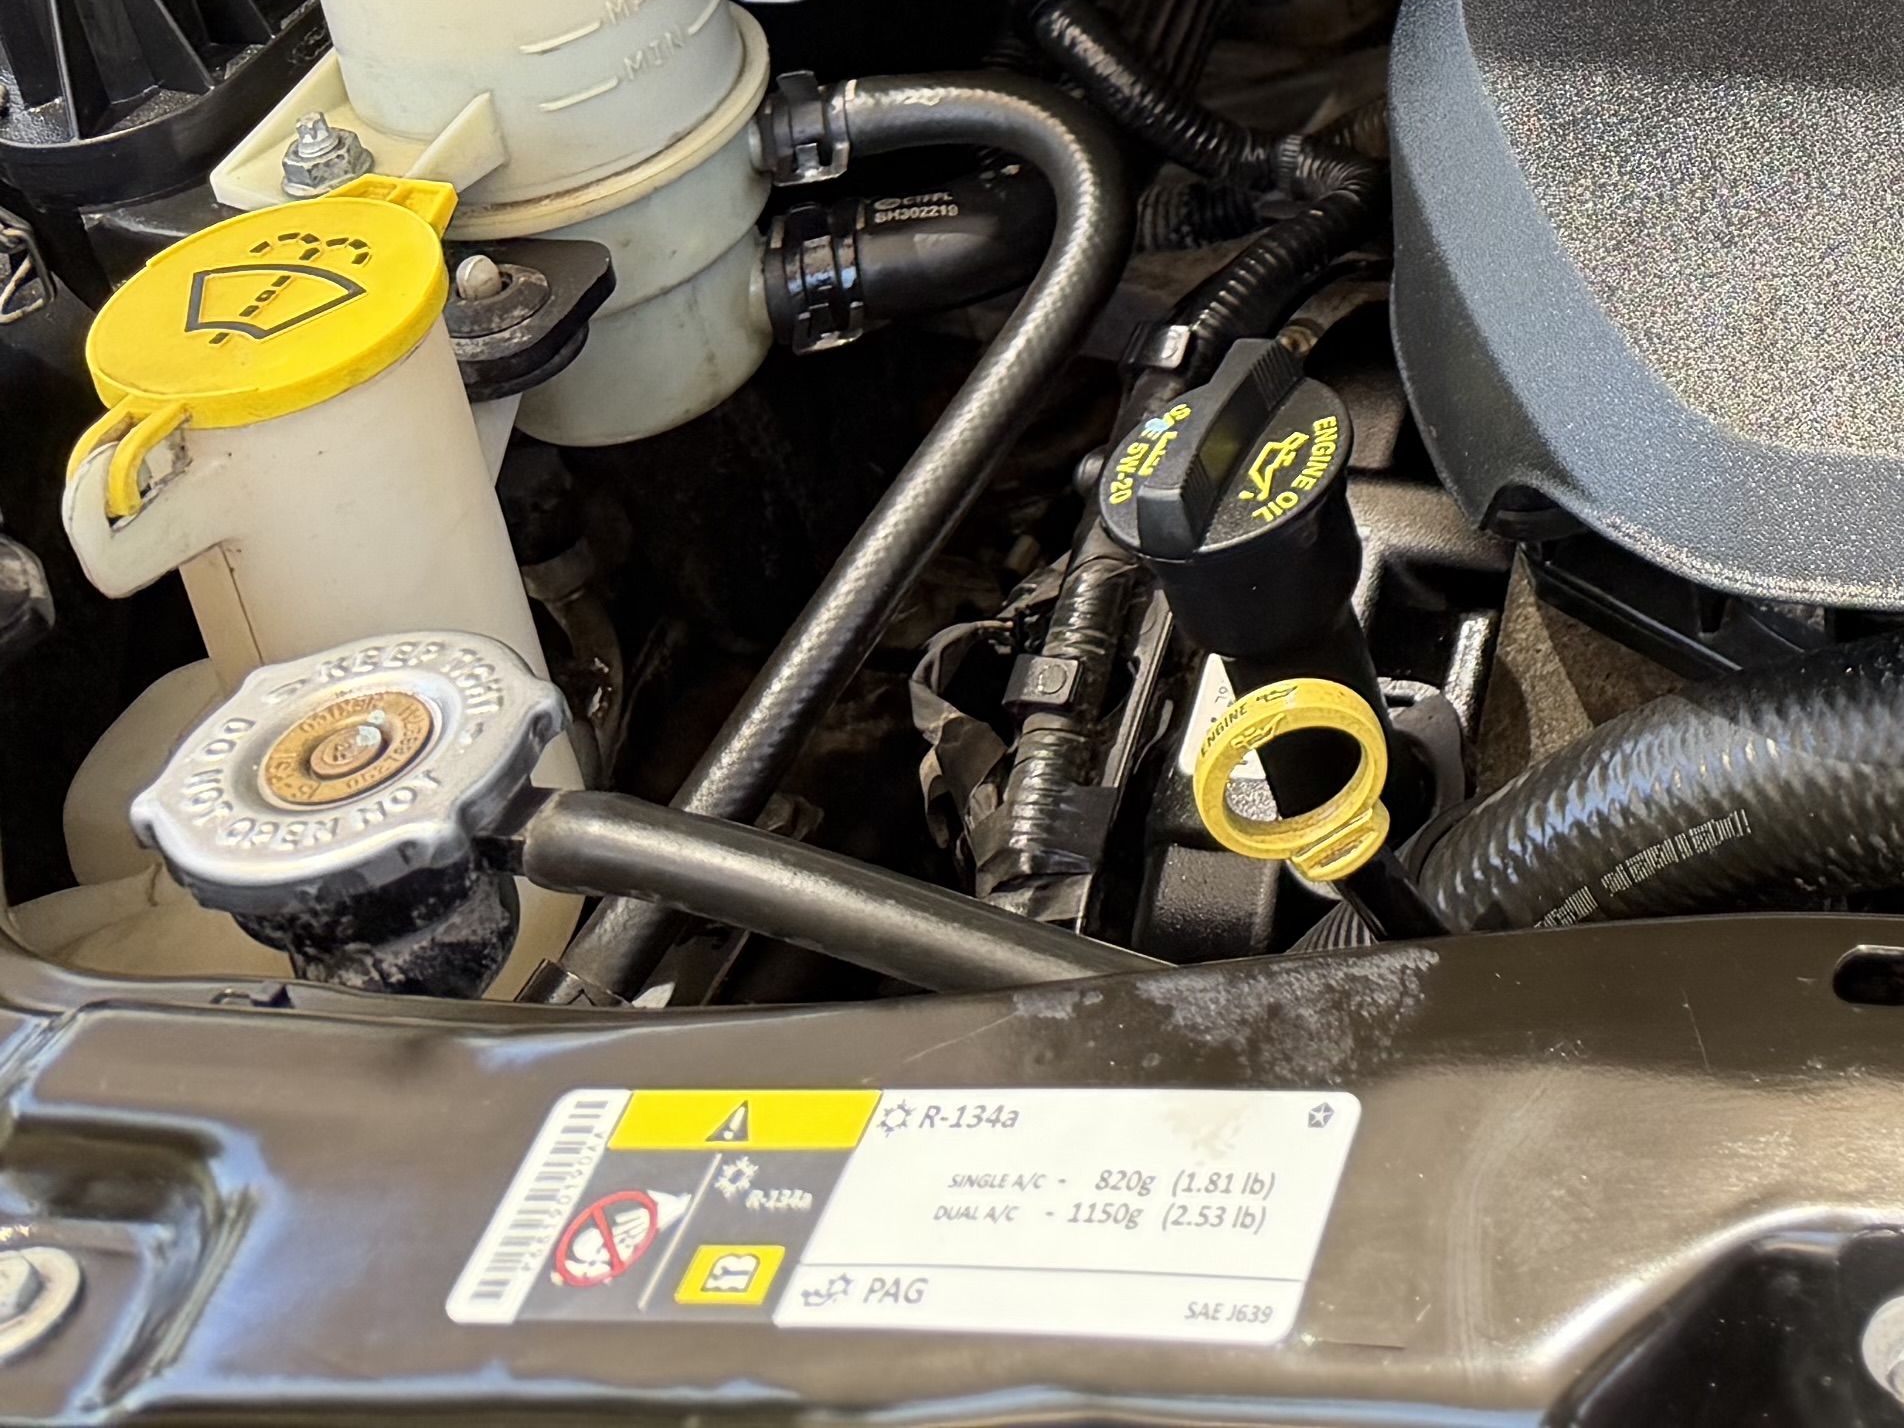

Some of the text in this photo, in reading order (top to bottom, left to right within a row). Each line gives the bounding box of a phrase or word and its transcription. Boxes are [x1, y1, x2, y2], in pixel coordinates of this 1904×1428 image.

[624, 20, 686, 80] MIN
[1109, 442, 1149, 505] 5W-20
[1252, 416, 1338, 523] ENGINE OIL
[205, 717, 256, 756] DO
[1200, 703, 1248, 758] ENGINE
[918, 1104, 1020, 1130] R-134a
[948, 1169, 1277, 1201] SINGLE A/C 820g (1.81 lb)
[933, 1202, 1267, 1235] DUAL A/C 1150g (2.53 lb)
[863, 1277, 928, 1305] PAG
[1184, 1301, 1274, 1325] SAE J639
